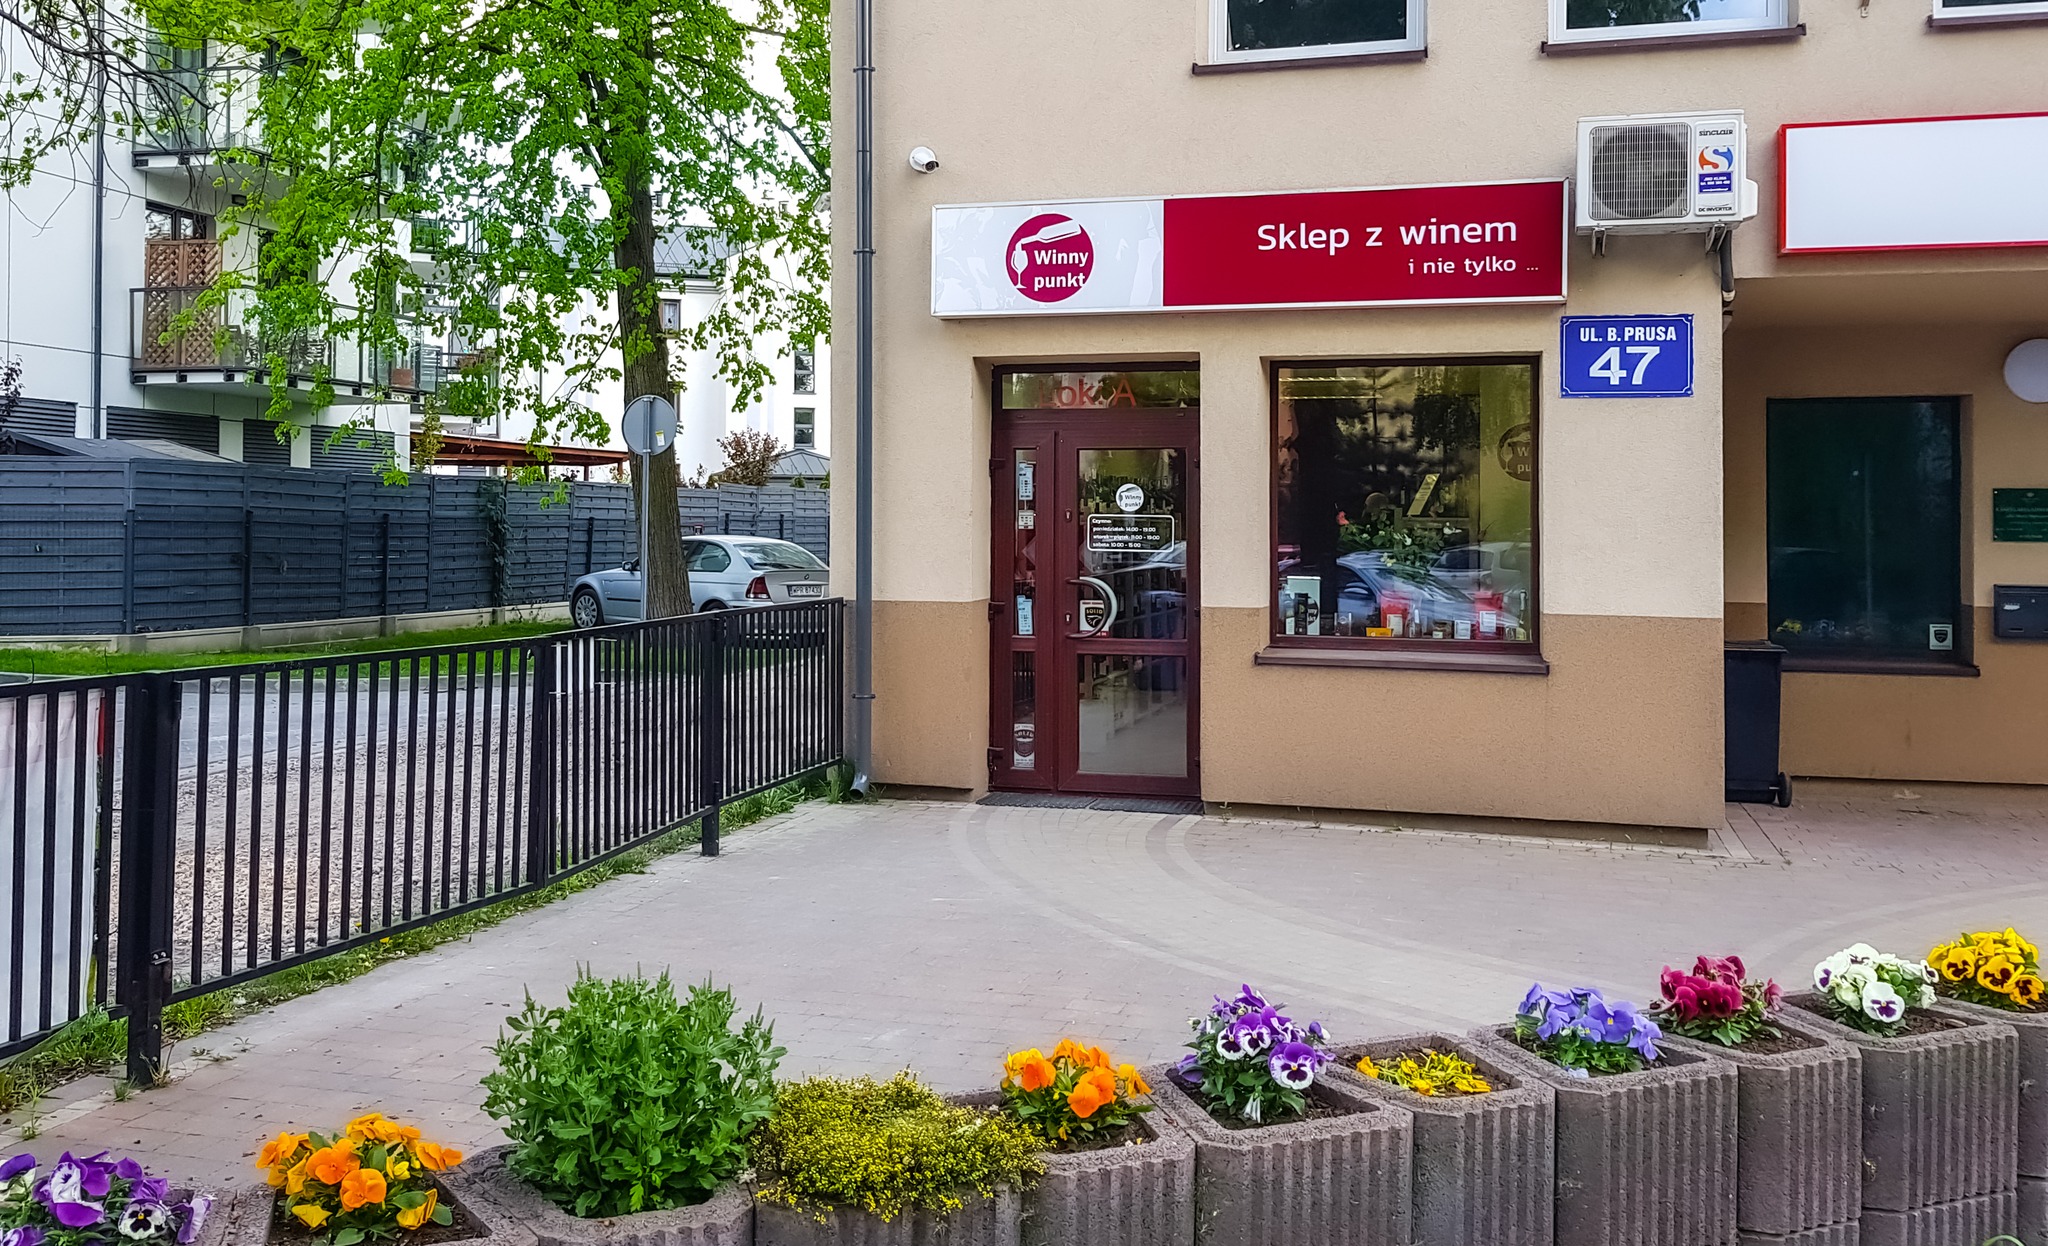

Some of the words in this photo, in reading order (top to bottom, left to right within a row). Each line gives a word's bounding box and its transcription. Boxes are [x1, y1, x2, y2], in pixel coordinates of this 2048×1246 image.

[1257, 222, 1350, 256] Sklep
[1365, 226, 1383, 247] z
[1399, 217, 1517, 246] winem
[1034, 249, 1088, 267] Winny
[1408, 258, 1415, 275] i
[1423, 257, 1456, 274] nie
[1463, 255, 1517, 276] tylko
[1034, 272, 1085, 291] punkt
[1580, 327, 1602, 341] UL.
[1607, 327, 1621, 341] B.
[1624, 326, 1677, 341] PRUSA
[1589, 345, 1660, 385] 47
[1112, 374, 1136, 407] A
